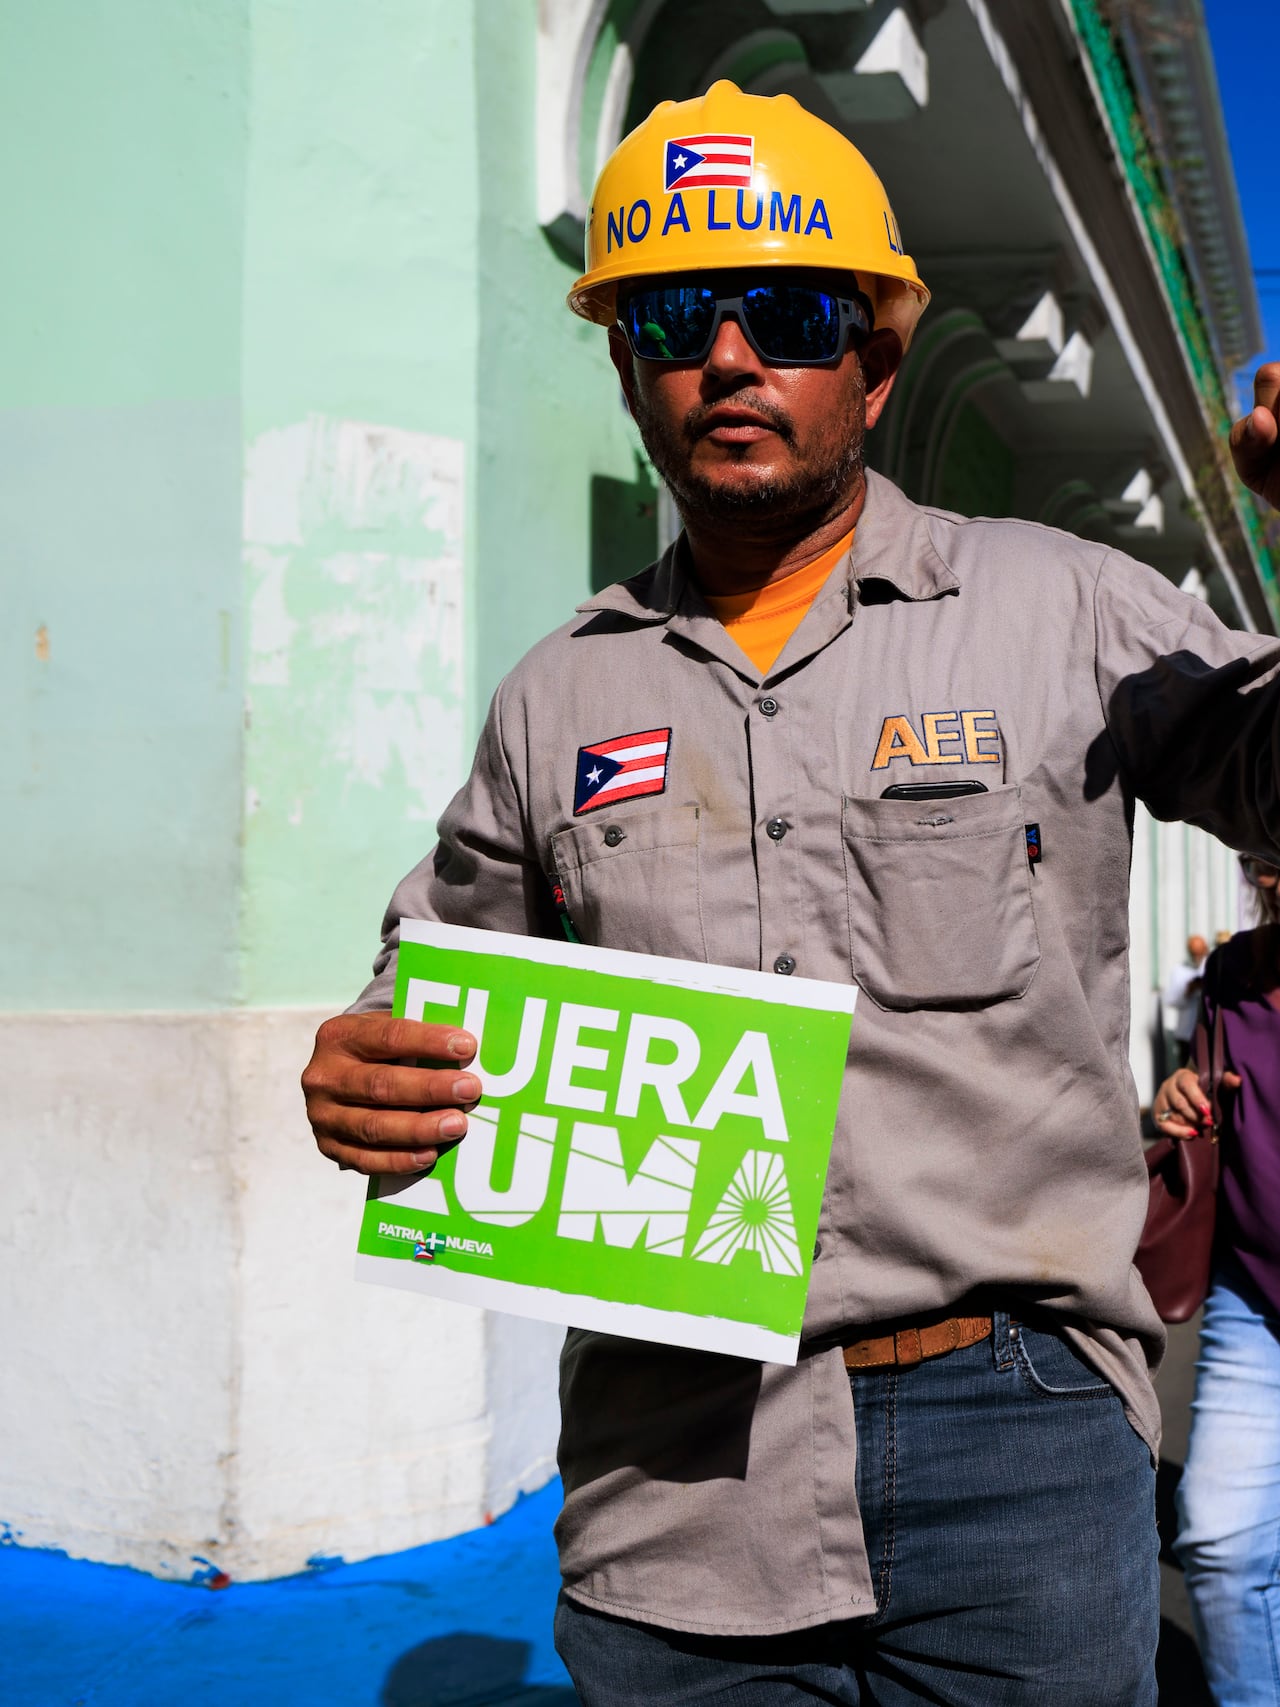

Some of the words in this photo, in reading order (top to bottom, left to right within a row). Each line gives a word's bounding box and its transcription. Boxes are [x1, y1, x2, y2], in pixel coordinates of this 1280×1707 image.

[607, 199, 652, 254] NO
[662, 192, 691, 236] A
[707, 189, 833, 240] LUMA
[870, 709, 1001, 772] AEE
[378, 1222, 424, 1243] PATRIA
[445, 1236, 494, 1256] NUEVA
